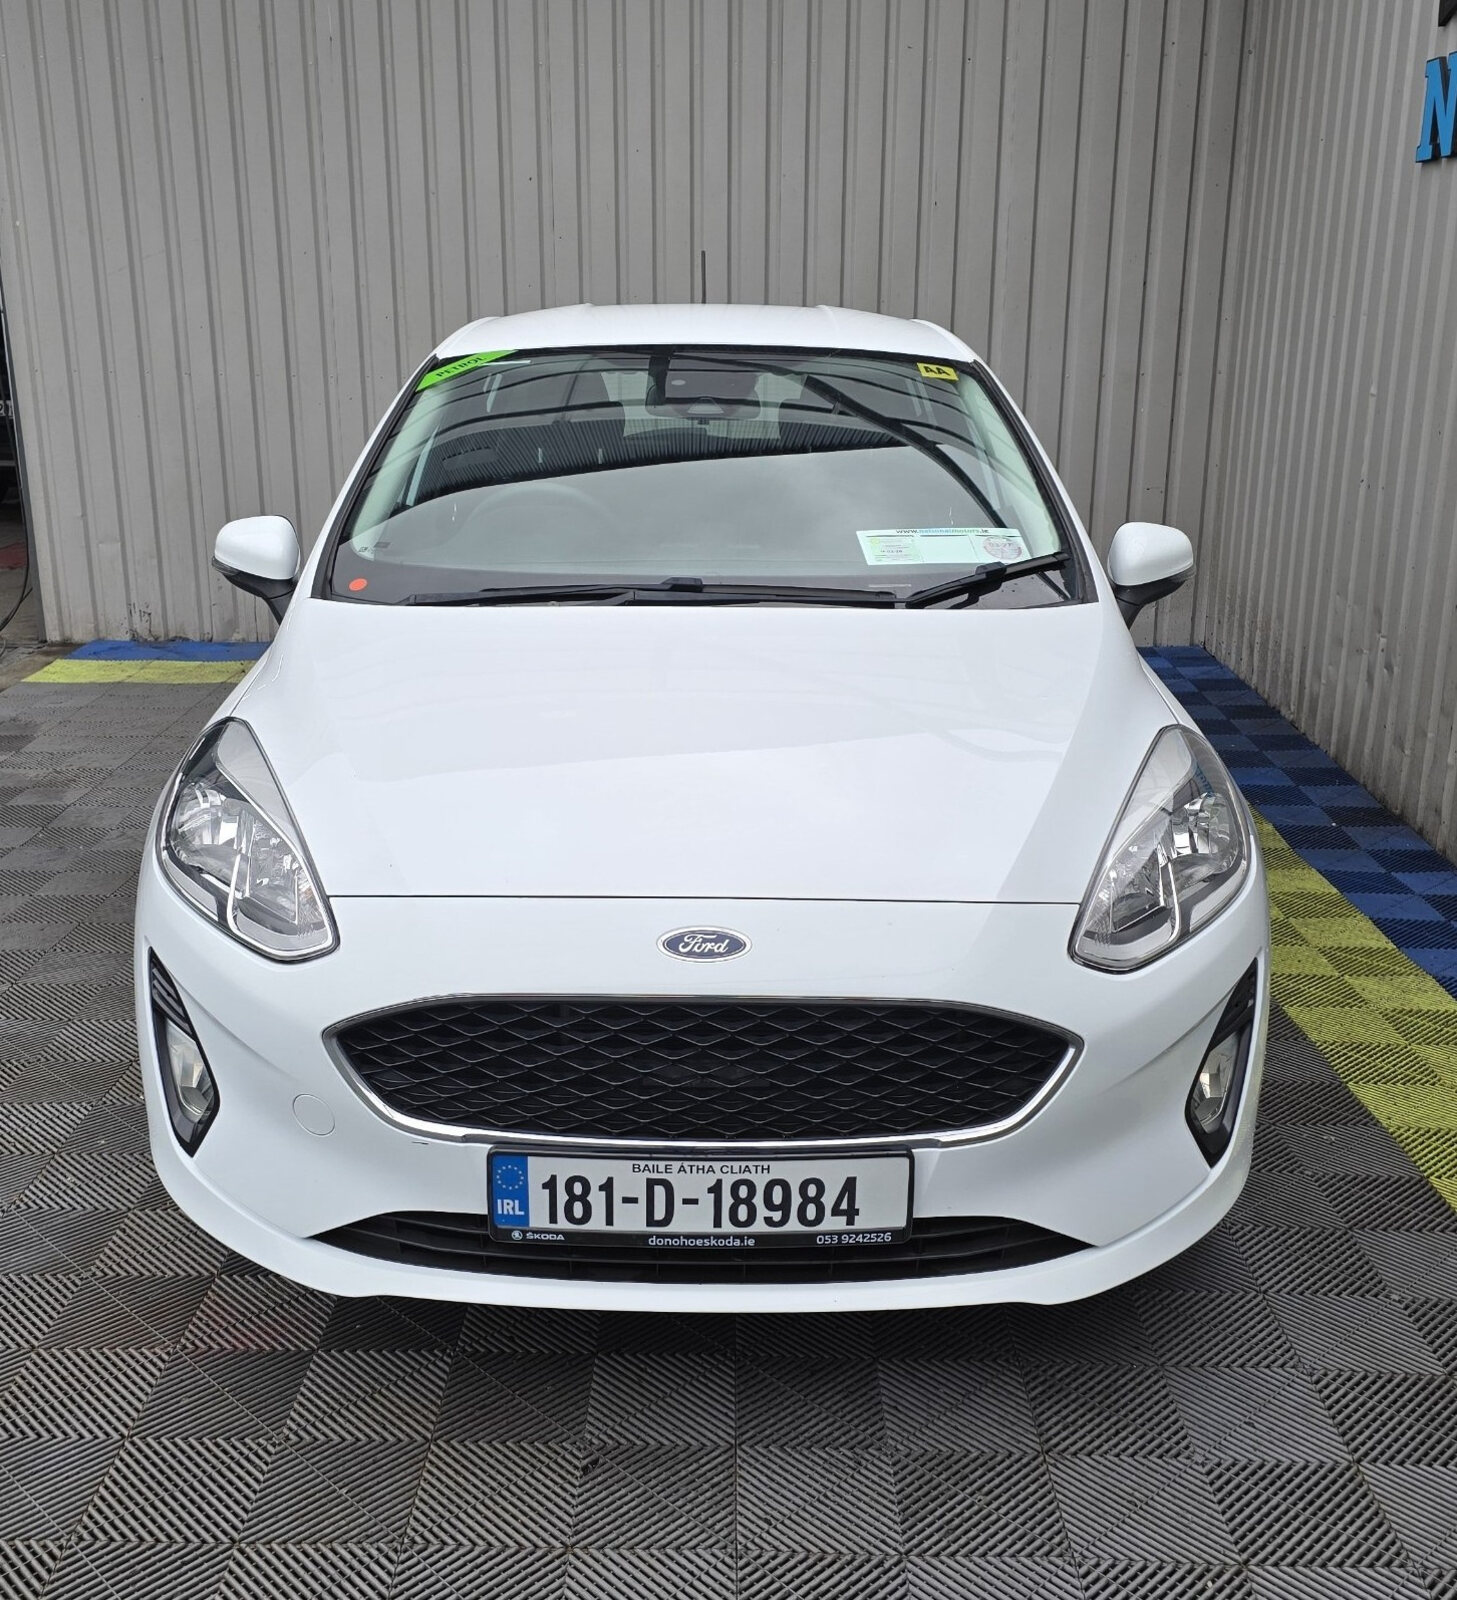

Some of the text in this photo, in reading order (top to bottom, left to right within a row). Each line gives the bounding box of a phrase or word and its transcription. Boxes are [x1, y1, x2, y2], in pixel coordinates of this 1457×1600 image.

[435, 356, 487, 377] PETROL
[923, 365, 951, 377] AA
[678, 933, 729, 953] Ford
[632, 1162, 771, 1175] BAILE ÁTHA CLIATH
[497, 1199, 525, 1216] IRL
[541, 1174, 860, 1229] 181-D-18984
[526, 1231, 565, 1241] ŠKODA
[648, 1235, 756, 1247] donohoeskoda.ie
[816, 1232, 892, 1244] 053 9242526
